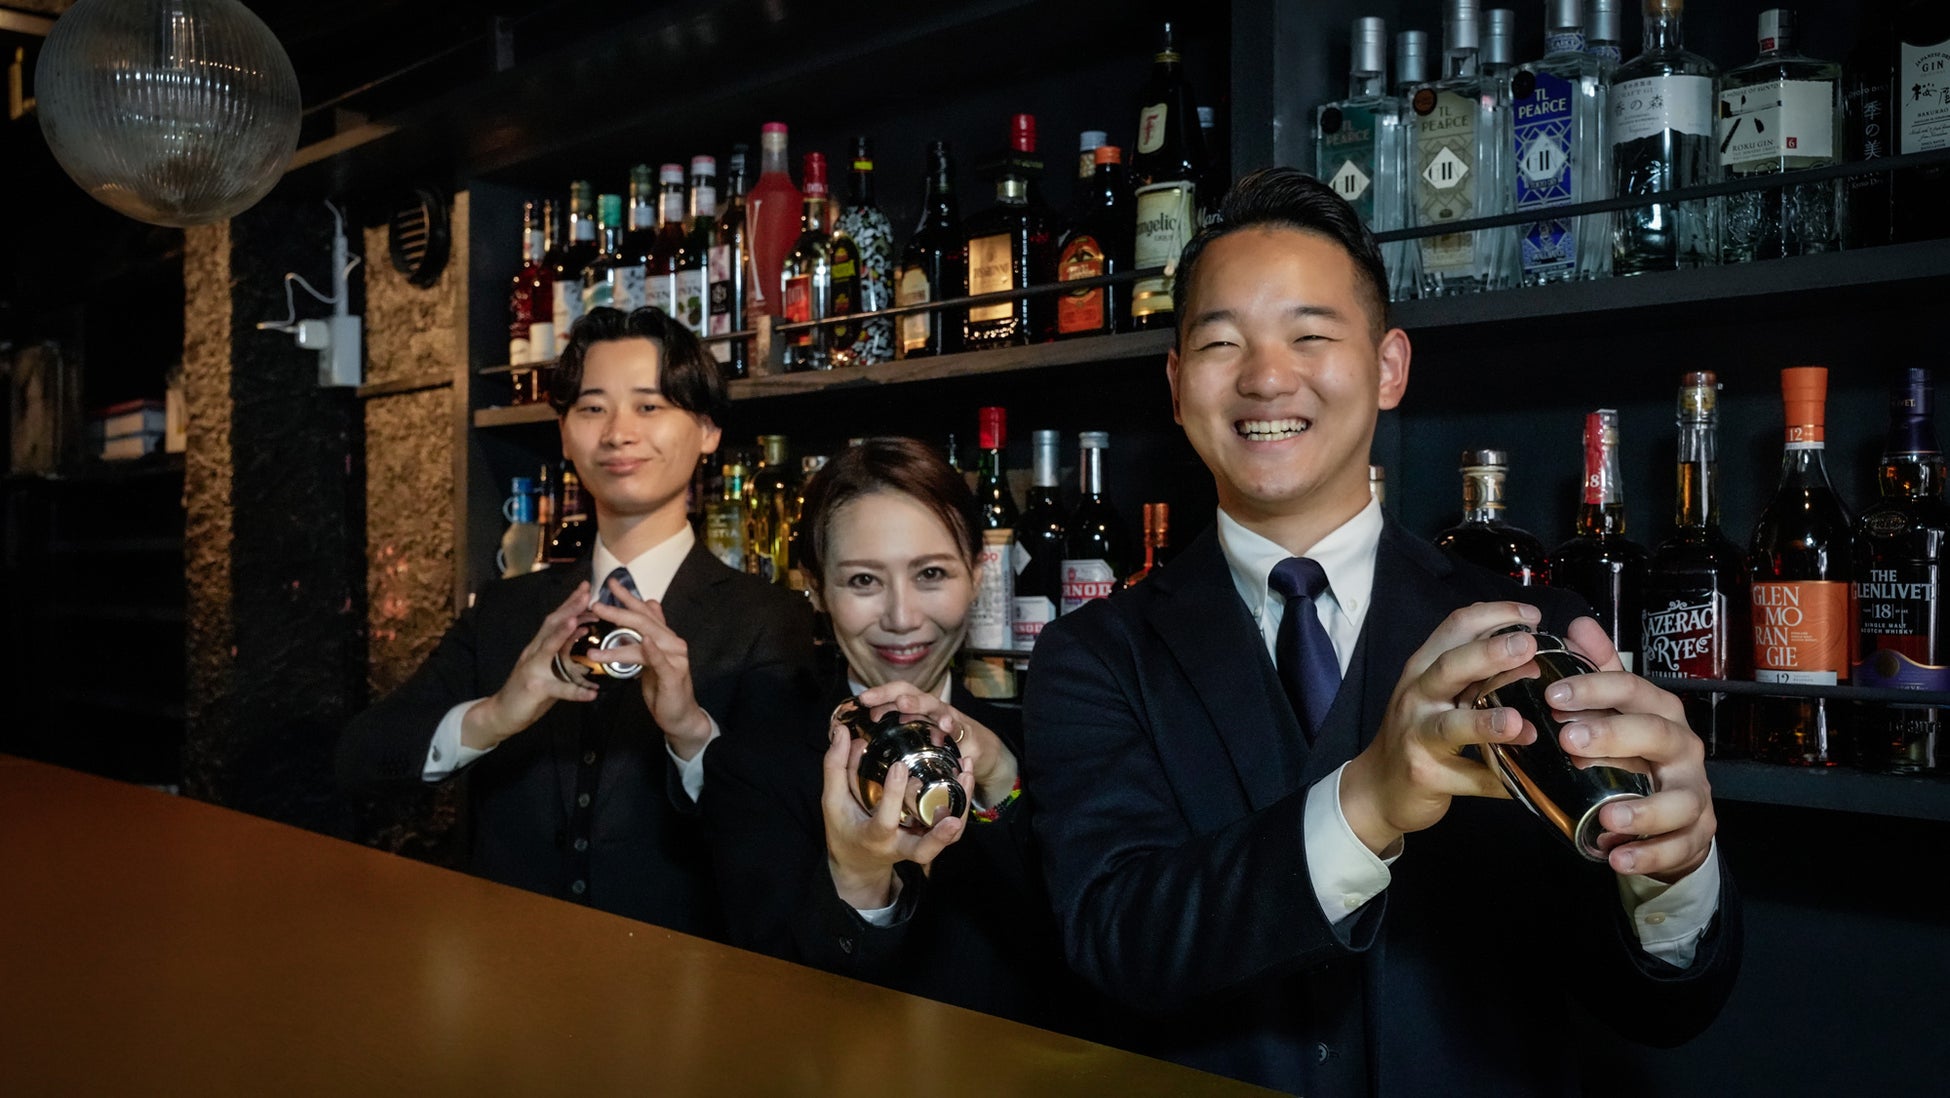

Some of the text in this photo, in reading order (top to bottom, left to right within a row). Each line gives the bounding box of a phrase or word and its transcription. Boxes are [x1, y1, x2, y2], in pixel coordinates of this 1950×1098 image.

[1922, 60, 1944, 72] GIN
[1535, 88, 1549, 101] TL
[1748, 86, 1757, 94] OF
[1440, 106, 1452, 117] TL
[1518, 98, 1567, 119] PEARCE
[1614, 94, 1664, 117] 香の森
[1143, 114, 1159, 146] F
[1421, 115, 1468, 133] PEARCE
[1864, 101, 1881, 161] 季の美
[1732, 139, 1774, 152] ROKU GIN
[1788, 138, 1797, 149] 6
[1789, 428, 1803, 441] 12
[1870, 569, 1898, 582] THE
[1752, 585, 1799, 607] GLEN
[1766, 606, 1803, 627] MO
[1874, 603, 1892, 619] 18
[1641, 608, 1714, 652] SAZERAC
[1885, 627, 1914, 636] WHISKY
[1888, 621, 1907, 629] MALT
[1755, 626, 1788, 646] RAN
[1653, 636, 1697, 671] RYE
[1766, 646, 1799, 667] GIE
